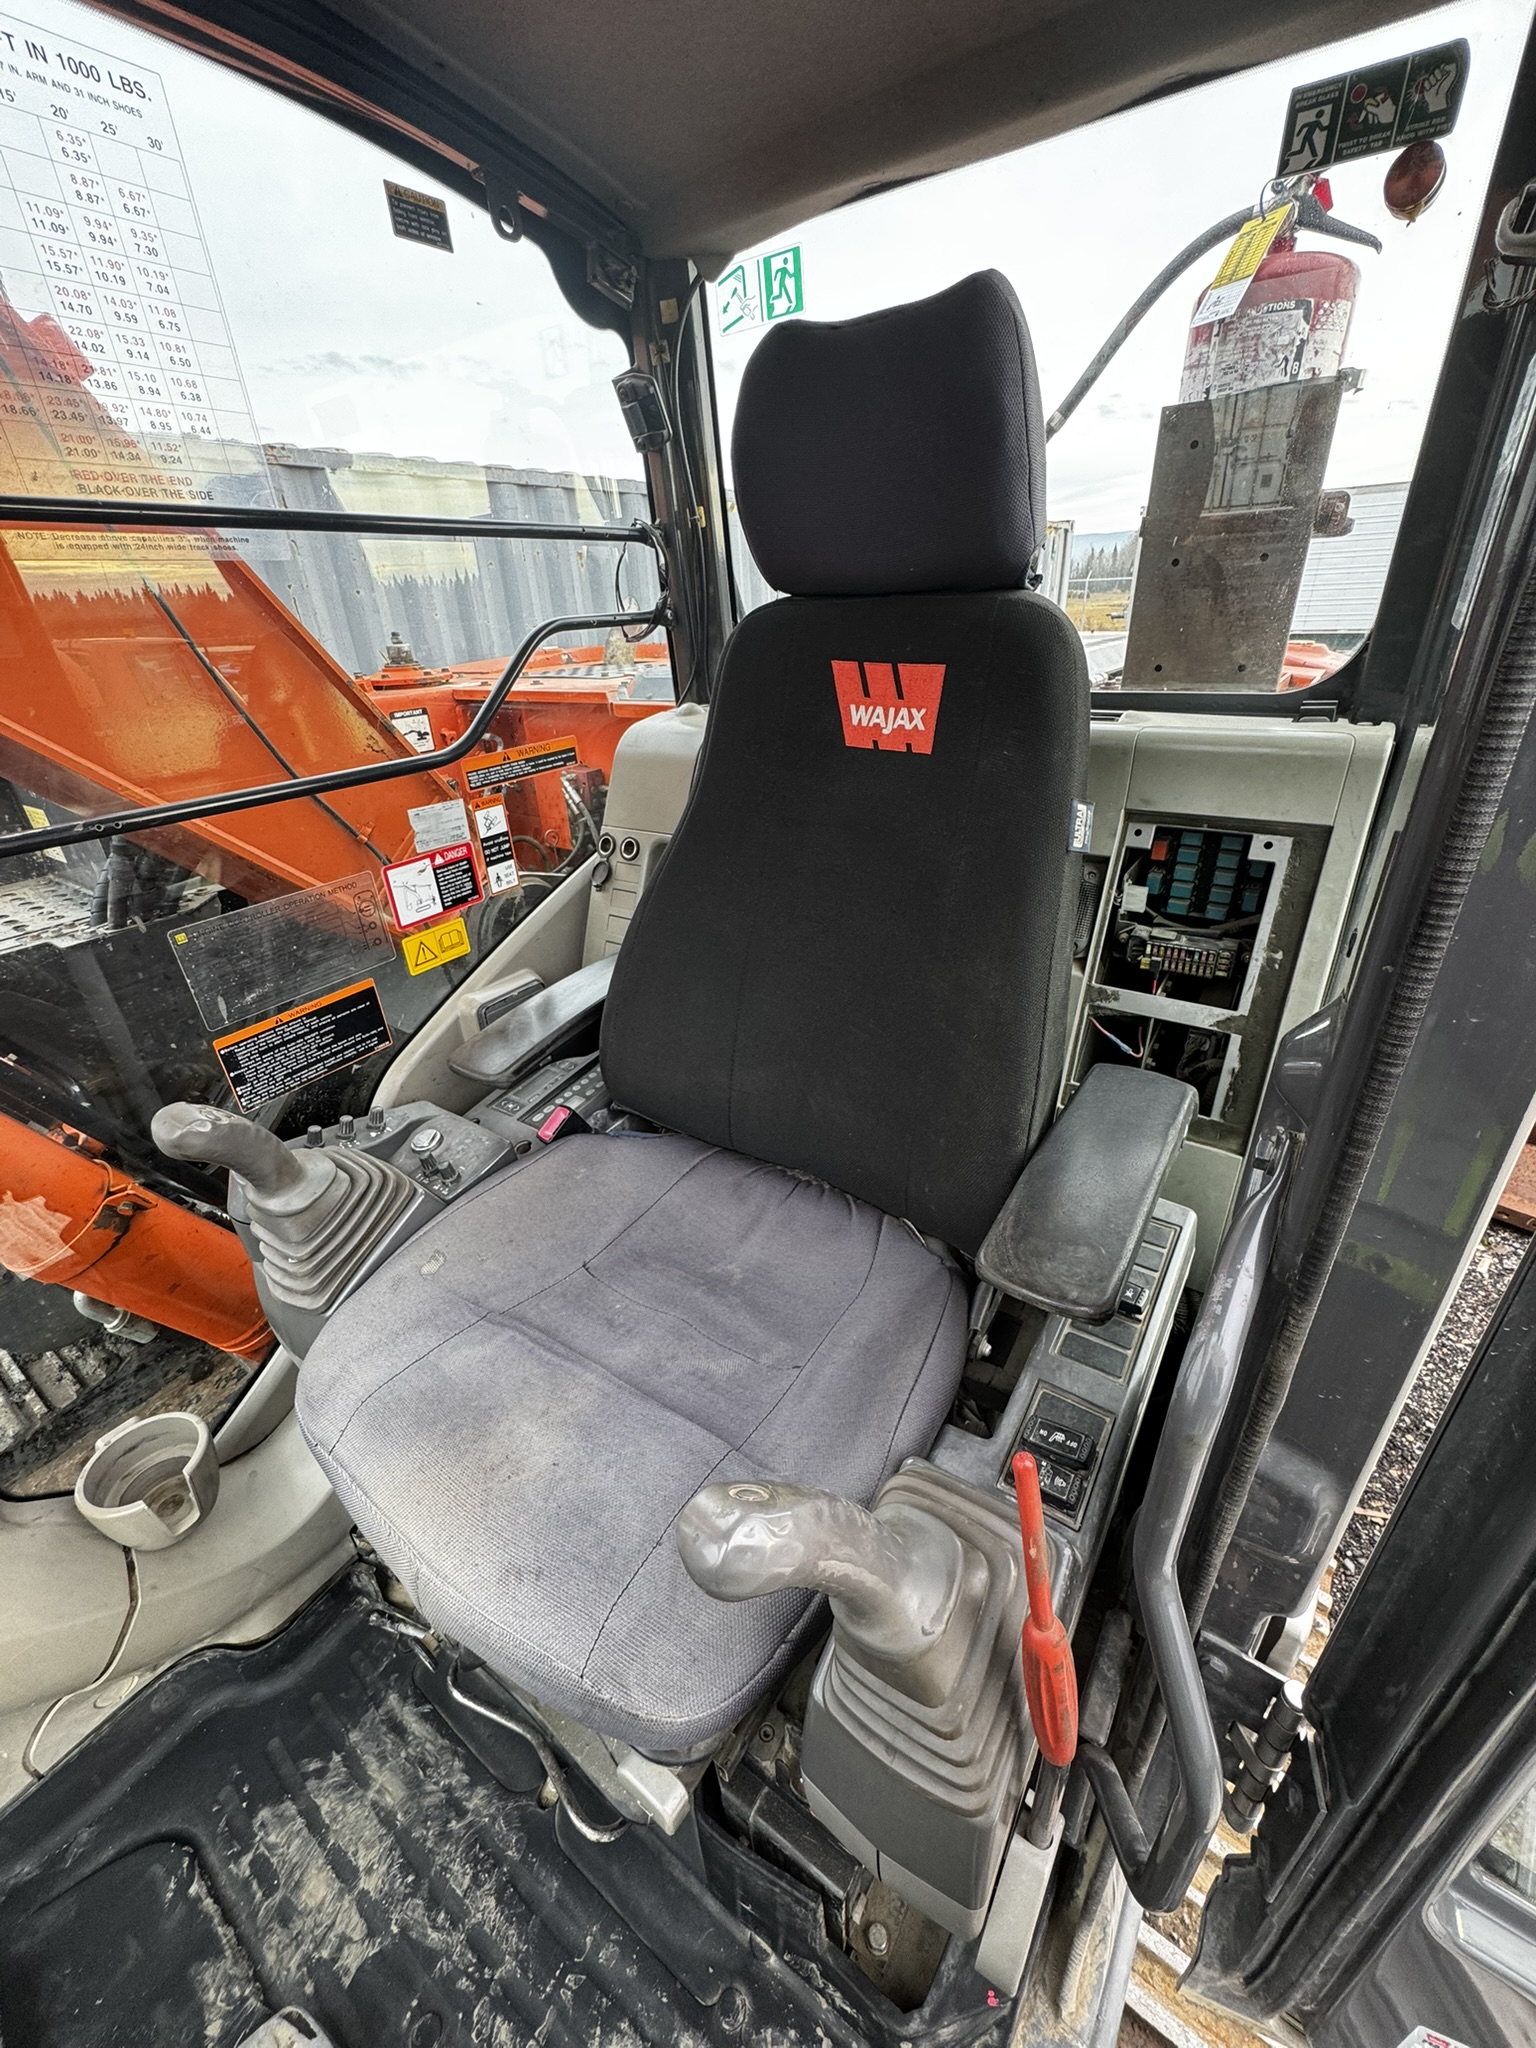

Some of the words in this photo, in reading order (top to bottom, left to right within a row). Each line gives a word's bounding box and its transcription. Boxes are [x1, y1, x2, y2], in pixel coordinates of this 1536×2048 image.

[24, 39, 48, 64] IN
[55, 52, 101, 83] 1000
[107, 70, 152, 102] LBS.
[26, 69, 48, 86] ARM
[51, 78, 71, 94] AND
[73, 86, 84, 99] 31
[87, 91, 110, 108] INCH
[112, 99, 143, 119] SHOES
[134, 243, 159, 258] 7.30
[95, 270, 126, 286] 10.19
[146, 281, 170, 295] 7.04
[60, 301, 93, 316] 14.70
[148, 304, 177, 319] 11.08
[114, 311, 138, 324] 9.59
[158, 320, 181, 332] 6.75
[115, 333, 146, 347] 15.33
[74, 340, 106, 354] 14.02
[159, 341, 186, 354] 10.81
[126, 349, 150, 361] 9.14
[169, 356, 192, 368] 6.50
[128, 370, 157, 384] 15.10
[170, 377, 198, 389] 10.68
[88, 379, 118, 391] 13.86
[139, 386, 161, 397] 8.94
[180, 391, 202, 402] 6.38
[181, 411, 208, 423] 10.74
[150, 420, 172, 431] 8.95
[191, 425, 212, 435] 6.44
[141, 473, 166, 485] THE
[169, 475, 193, 487] END
[161, 488, 185, 500] THE
[189, 490, 214, 501] SIDE
[52, 533, 97, 541] Decrease
[98, 533, 127, 541] above
[218, 536, 250, 544] machine
[393, 709, 423, 718] IMPORTANT
[849, 704, 927, 735] WAJAX
[516, 743, 551, 758] WARNING
[443, 846, 468, 860] DANGER
[491, 845, 499, 853] NOT
[500, 843, 510, 851] JUMP
[228, 905, 281, 928] CONTROLLER
[283, 893, 326, 912] OPERATION
[327, 881, 357, 897] METHOD
[288, 1001, 323, 1019] WARNING
[1040, 1428, 1048, 1437] ON
[1066, 1440, 1078, 1448] OFF
